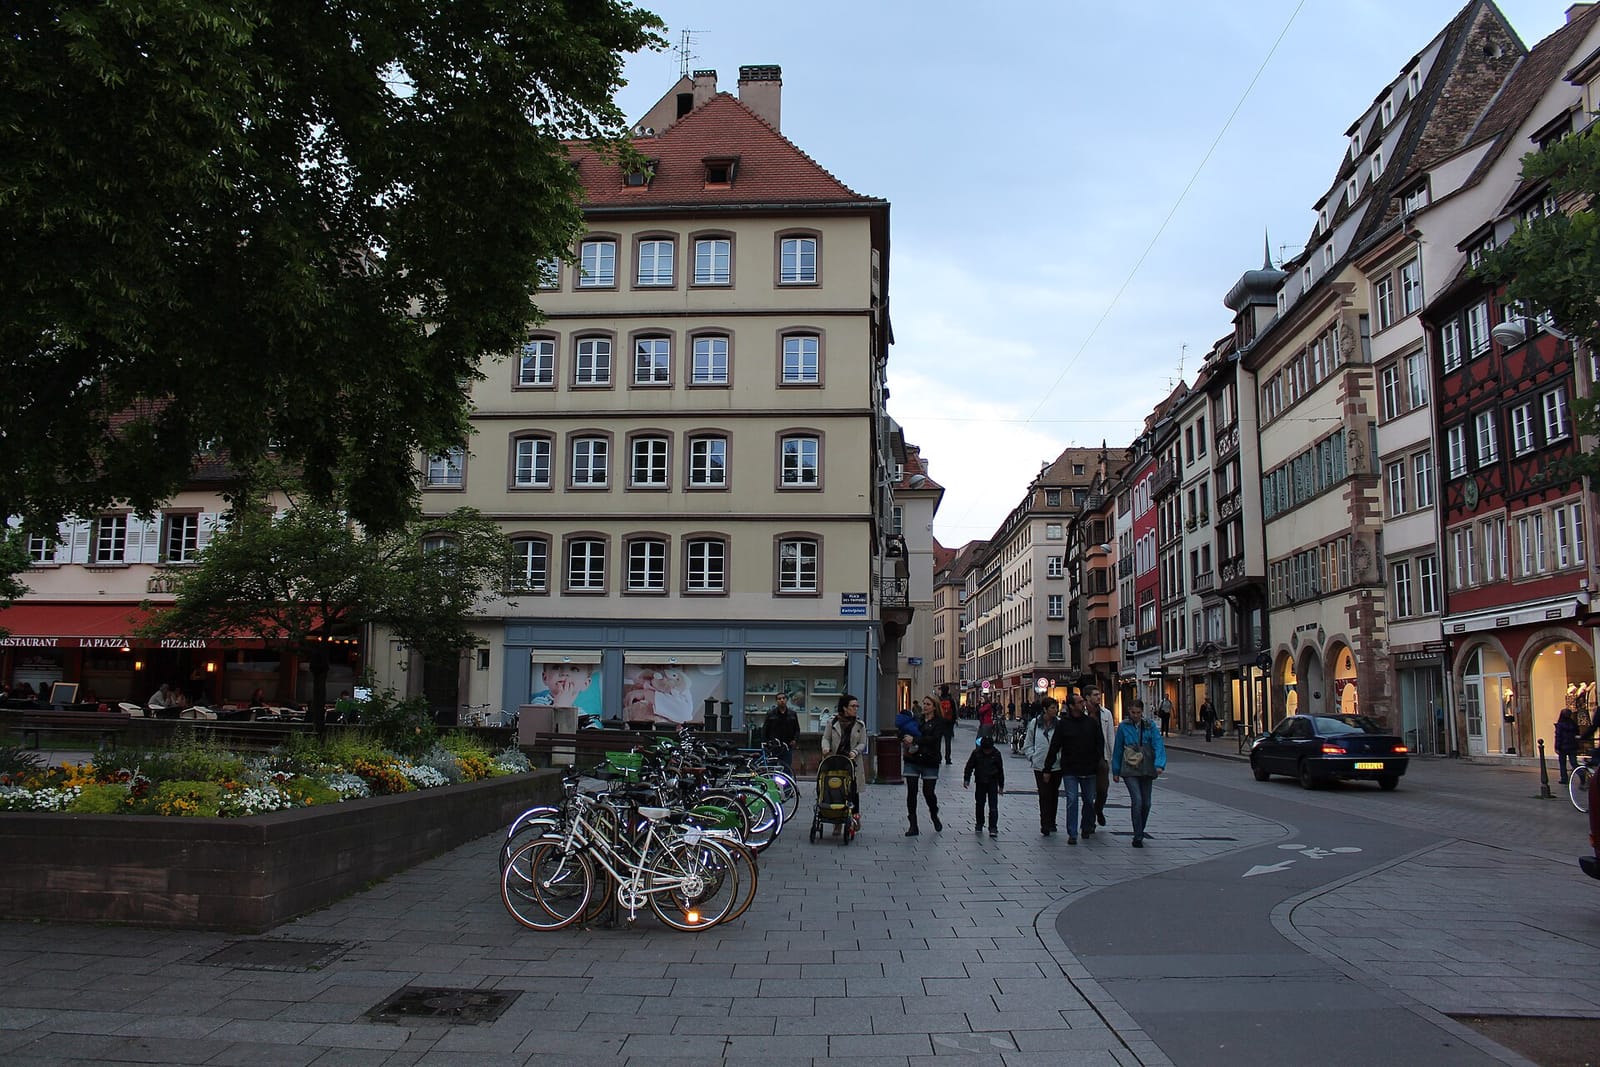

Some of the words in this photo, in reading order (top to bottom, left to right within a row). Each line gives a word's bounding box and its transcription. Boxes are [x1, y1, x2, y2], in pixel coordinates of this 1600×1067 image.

[80, 638, 92, 647] LA
[94, 638, 130, 648] PIAZZA
[161, 639, 206, 648] PIZZERIA
